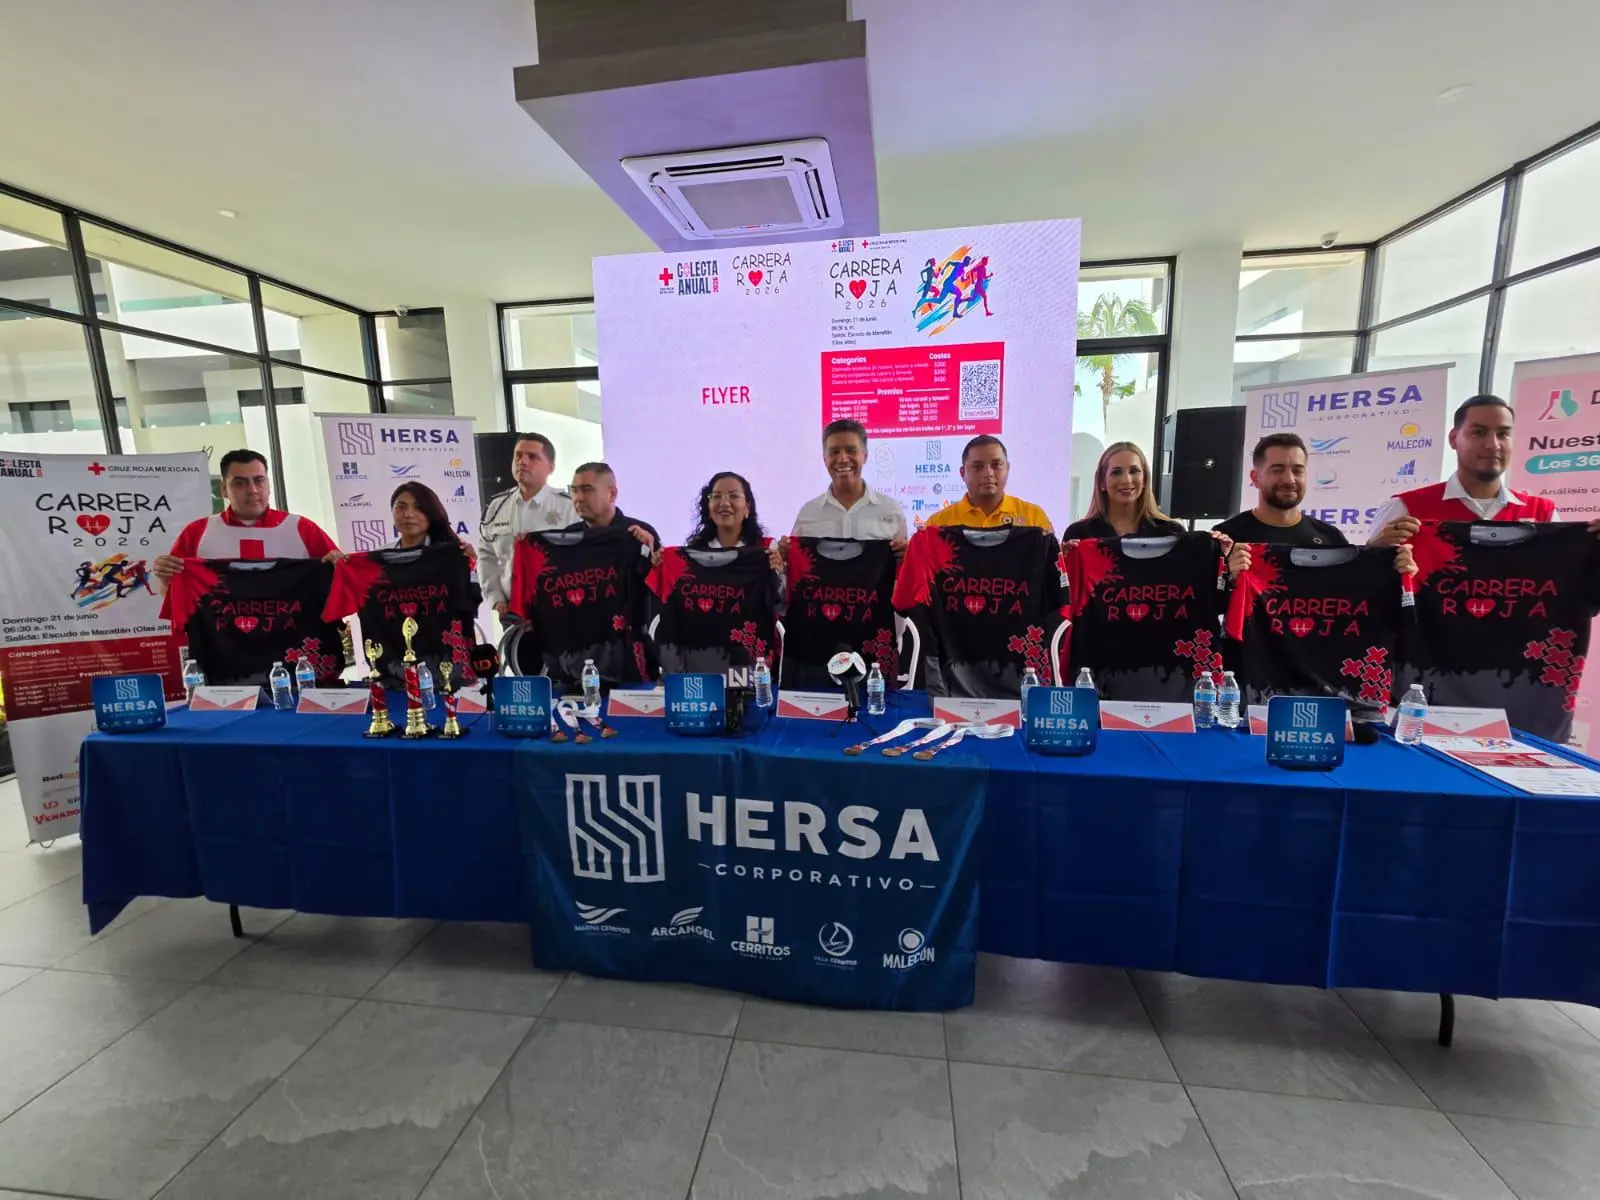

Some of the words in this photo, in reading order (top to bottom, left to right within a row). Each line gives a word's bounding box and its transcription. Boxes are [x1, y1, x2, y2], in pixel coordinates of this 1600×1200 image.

[732, 252, 792, 270] CARRERA
[829, 258, 902, 279] CARRERA
[678, 277, 711, 296] ANUAL
[745, 287, 780, 296] 2026
[845, 299, 887, 310] 2026
[928, 352, 951, 360] Costos
[702, 385, 751, 405] FLYER
[876, 388, 904, 396] Premios
[1308, 385, 1423, 413] HERSA
[1319, 409, 1410, 422] CORPORATIVO
[380, 428, 459, 443] HERSA
[1387, 437, 1432, 450] MALECÓN
[154, 465, 200, 473] MEXICANA
[915, 463, 951, 474] HERSA
[1538, 459, 1571, 470] Los
[1540, 487, 1588, 495] Análisis
[35, 493, 172, 512] CARRERA
[72, 536, 150, 547] 2026
[544, 565, 618, 593] CARRERA
[942, 578, 1029, 596] CARRERA
[376, 583, 449, 604] CARRERA
[681, 583, 745, 599] CARRERA
[802, 586, 879, 604] CARRERA
[1102, 585, 1196, 604] CARRERA
[1437, 578, 1558, 597] CARRERA
[210, 599, 302, 616] CARRERA
[1265, 598, 1369, 617] CARRERA
[2, 616, 49, 625] Domingo
[76, 612, 98, 621] junio
[5, 633, 40, 642] Salida:
[42, 630, 78, 639] Escudo
[91, 625, 131, 636] Mazatlán
[133, 625, 156, 634] (Olas
[79, 670, 113, 678] Premios
[101, 699, 158, 713] HERSA
[500, 704, 545, 716] HERSA
[671, 701, 718, 713] HERSA
[1034, 716, 1089, 730] HERSA
[1274, 730, 1336, 745] HERSA
[686, 791, 940, 862] HERSA
[715, 863, 914, 891] CORPORATIVO
[651, 925, 716, 941] ARCANGEL
[731, 940, 791, 956] CERRITOS
